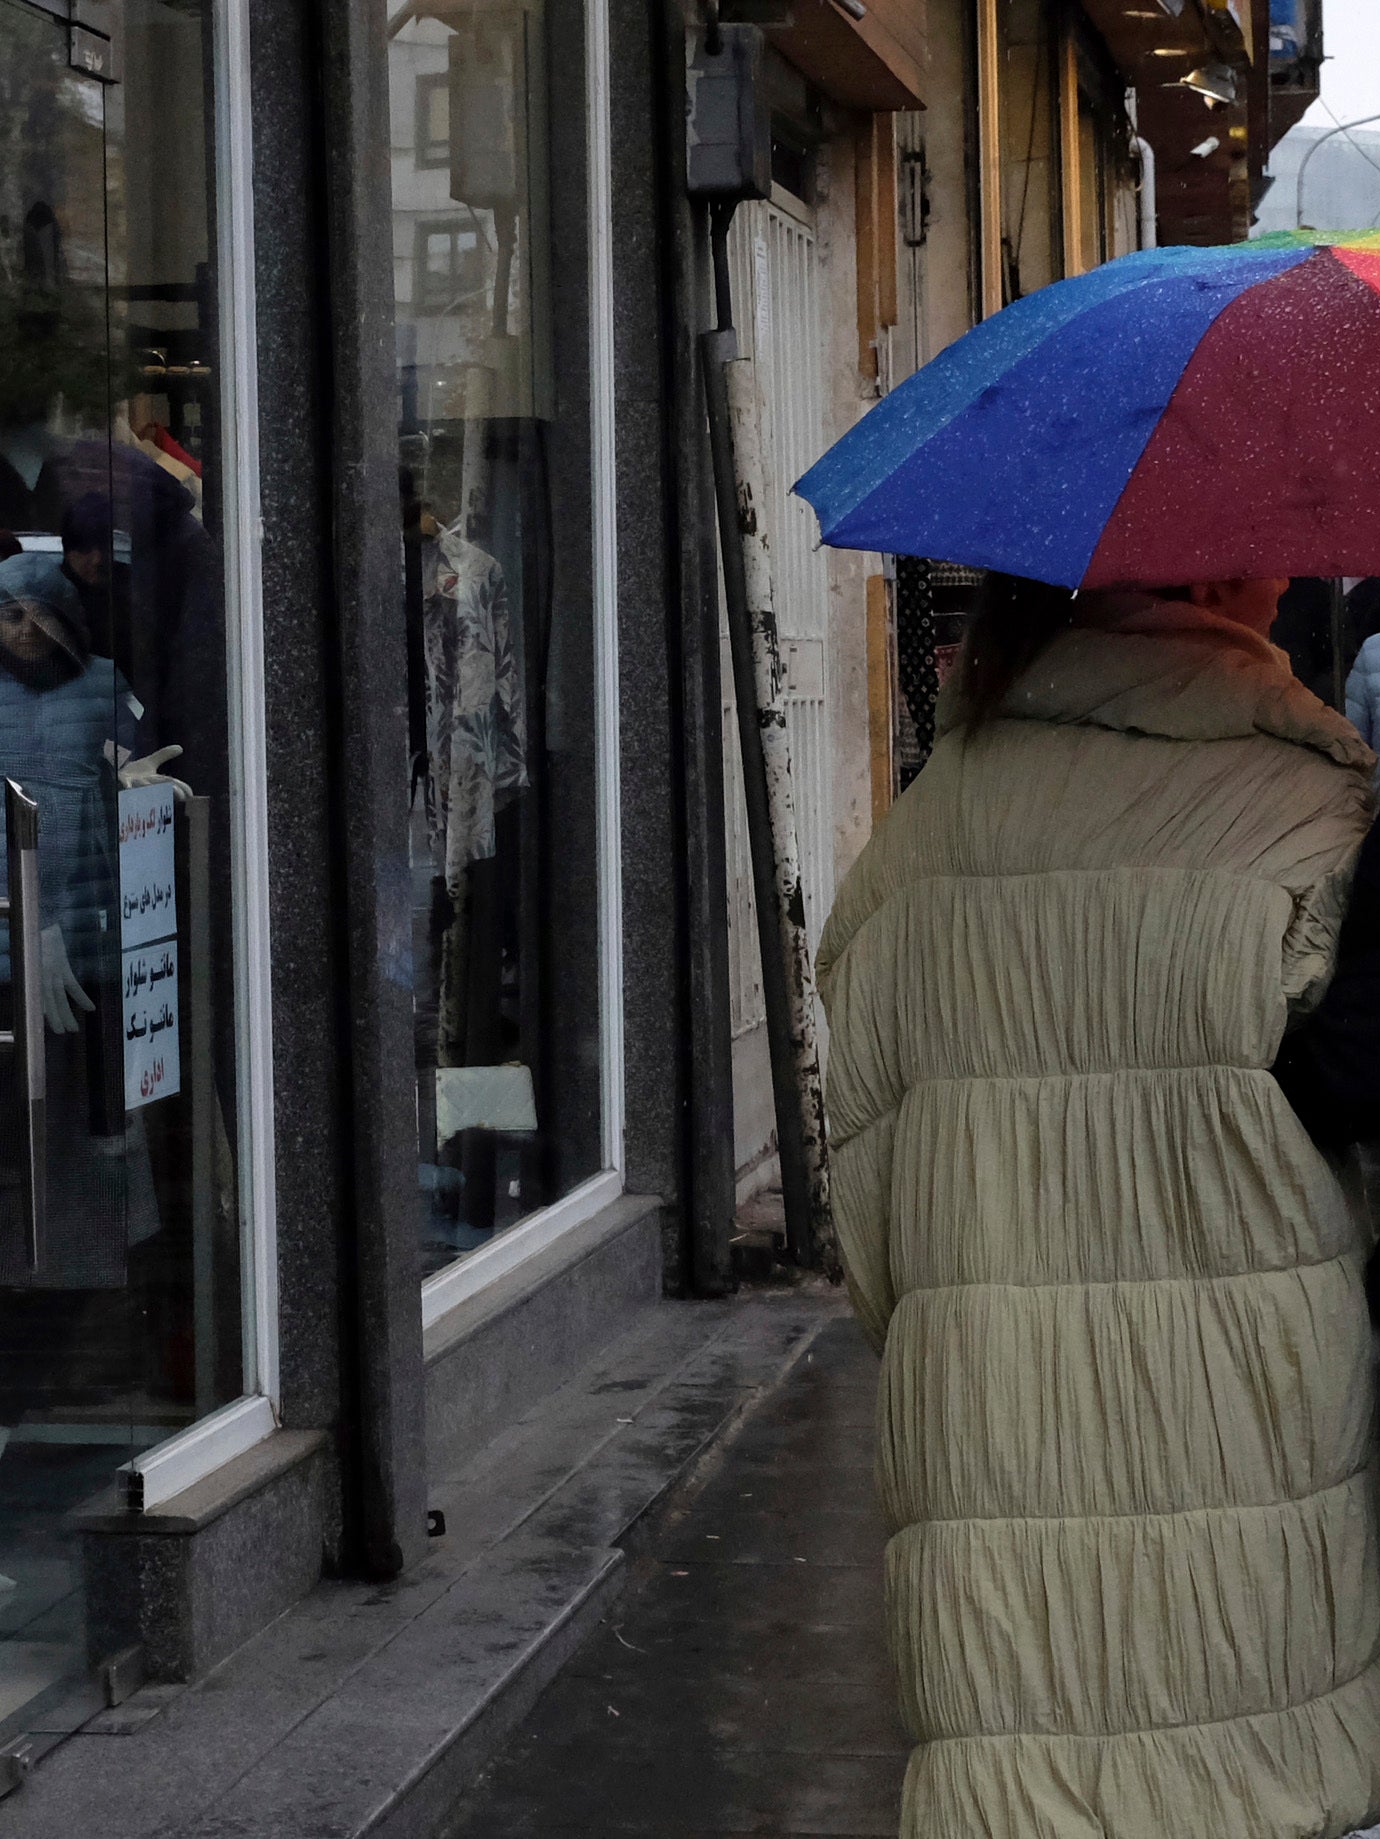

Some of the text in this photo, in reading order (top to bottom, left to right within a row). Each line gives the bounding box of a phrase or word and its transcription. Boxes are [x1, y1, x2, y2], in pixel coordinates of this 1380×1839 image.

[157, 804, 172, 835] شلوار
[140, 886, 151, 914] های
[151, 883, 164, 911] مدل
[164, 884, 172, 909] در
[125, 952, 174, 998] مانتو شلوار
[126, 1003, 174, 1043] مانتو تک
[140, 1056, 164, 1097] اداری
